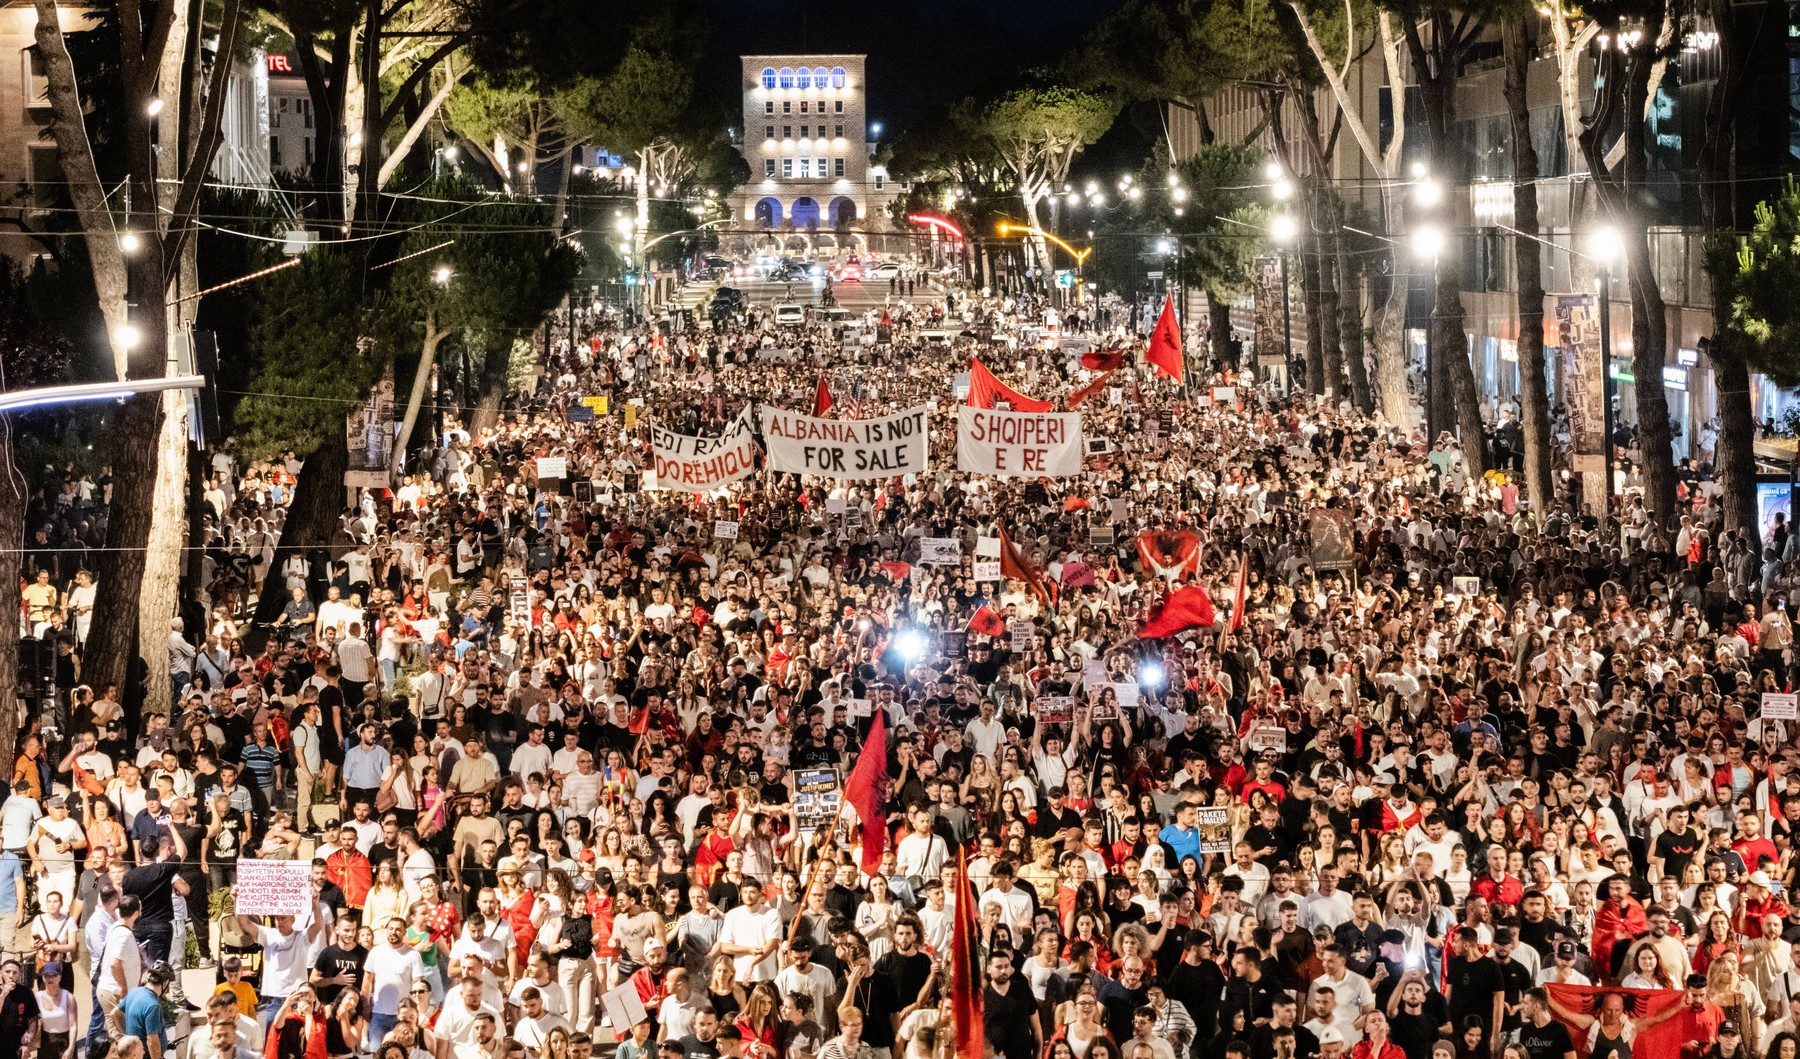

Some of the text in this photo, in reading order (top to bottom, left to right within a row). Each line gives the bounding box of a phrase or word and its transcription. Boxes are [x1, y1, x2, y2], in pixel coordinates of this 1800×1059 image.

[267, 54, 292, 71] TEL
[653, 427, 682, 453] EDI
[770, 412, 925, 443] ALBANIA IS NOT
[971, 413, 1065, 444] SHQIPËRI
[656, 443, 751, 485] DORËHIQU
[804, 445, 909, 472] FOR SALE
[995, 448, 1049, 471] E RE
[806, 752, 828, 760] chill
